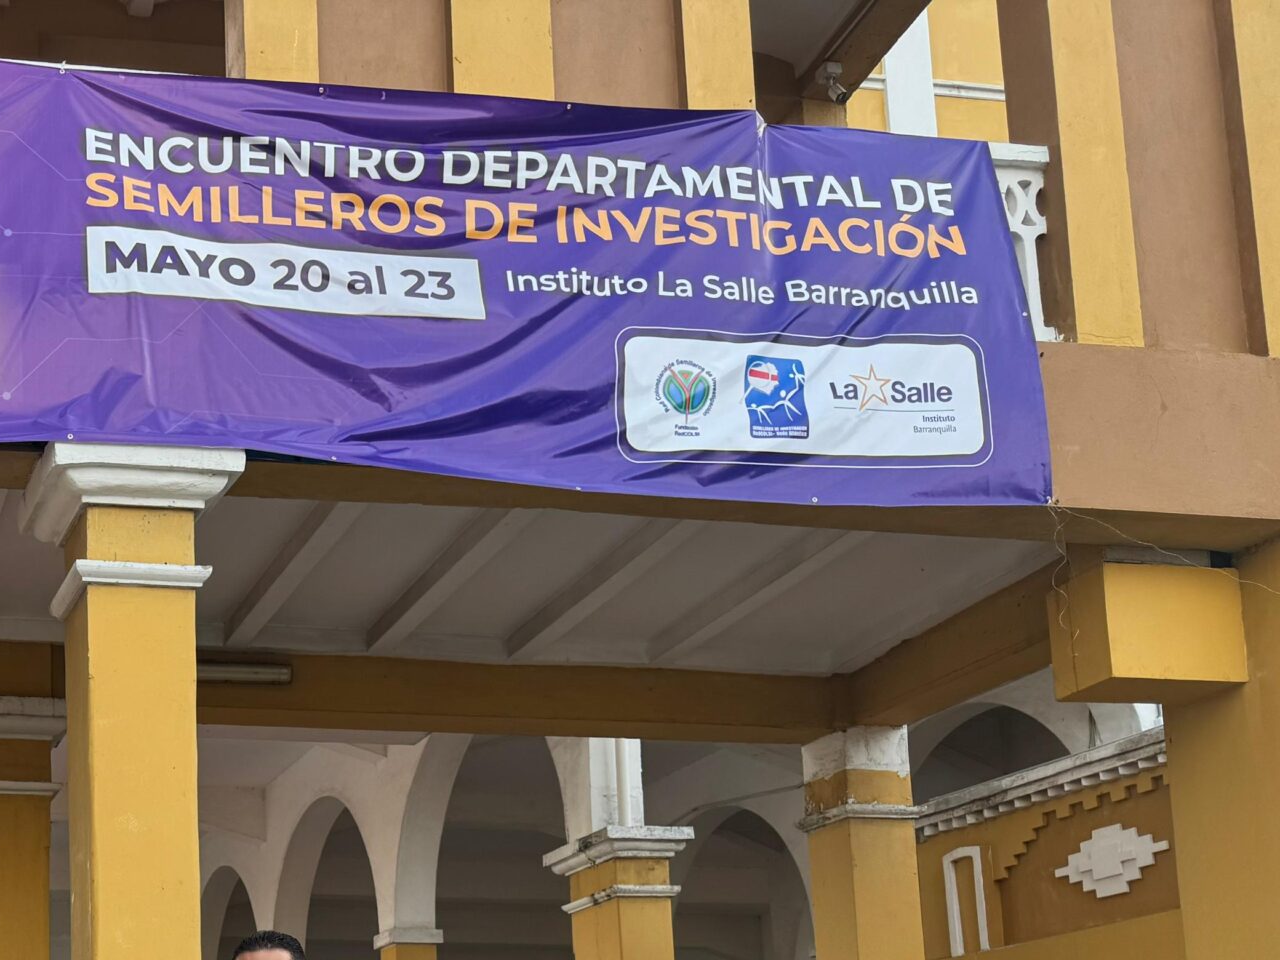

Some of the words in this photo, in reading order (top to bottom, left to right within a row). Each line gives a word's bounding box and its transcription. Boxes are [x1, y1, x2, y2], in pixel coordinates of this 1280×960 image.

[85, 128, 425, 182] ENCUENTRO
[442, 150, 881, 209] DEPARTAMENTAL
[891, 178, 955, 216] DE
[86, 172, 445, 236] SEMILLEROS
[465, 199, 538, 243] DE
[556, 205, 967, 259] INVESTIGACIÓN
[104, 240, 256, 287] MAYO
[269, 259, 330, 293] 20
[346, 265, 387, 295] al
[399, 269, 455, 301] 23
[506, 267, 648, 297] Instituto
[658, 271, 693, 298] La
[702, 274, 775, 305] Salle
[785, 279, 978, 311] Barranquilla
[829, 382, 858, 400] La
[891, 381, 953, 403] Salle
[913, 426, 957, 435] Barranquilla
[922, 415, 955, 423] Instituto
